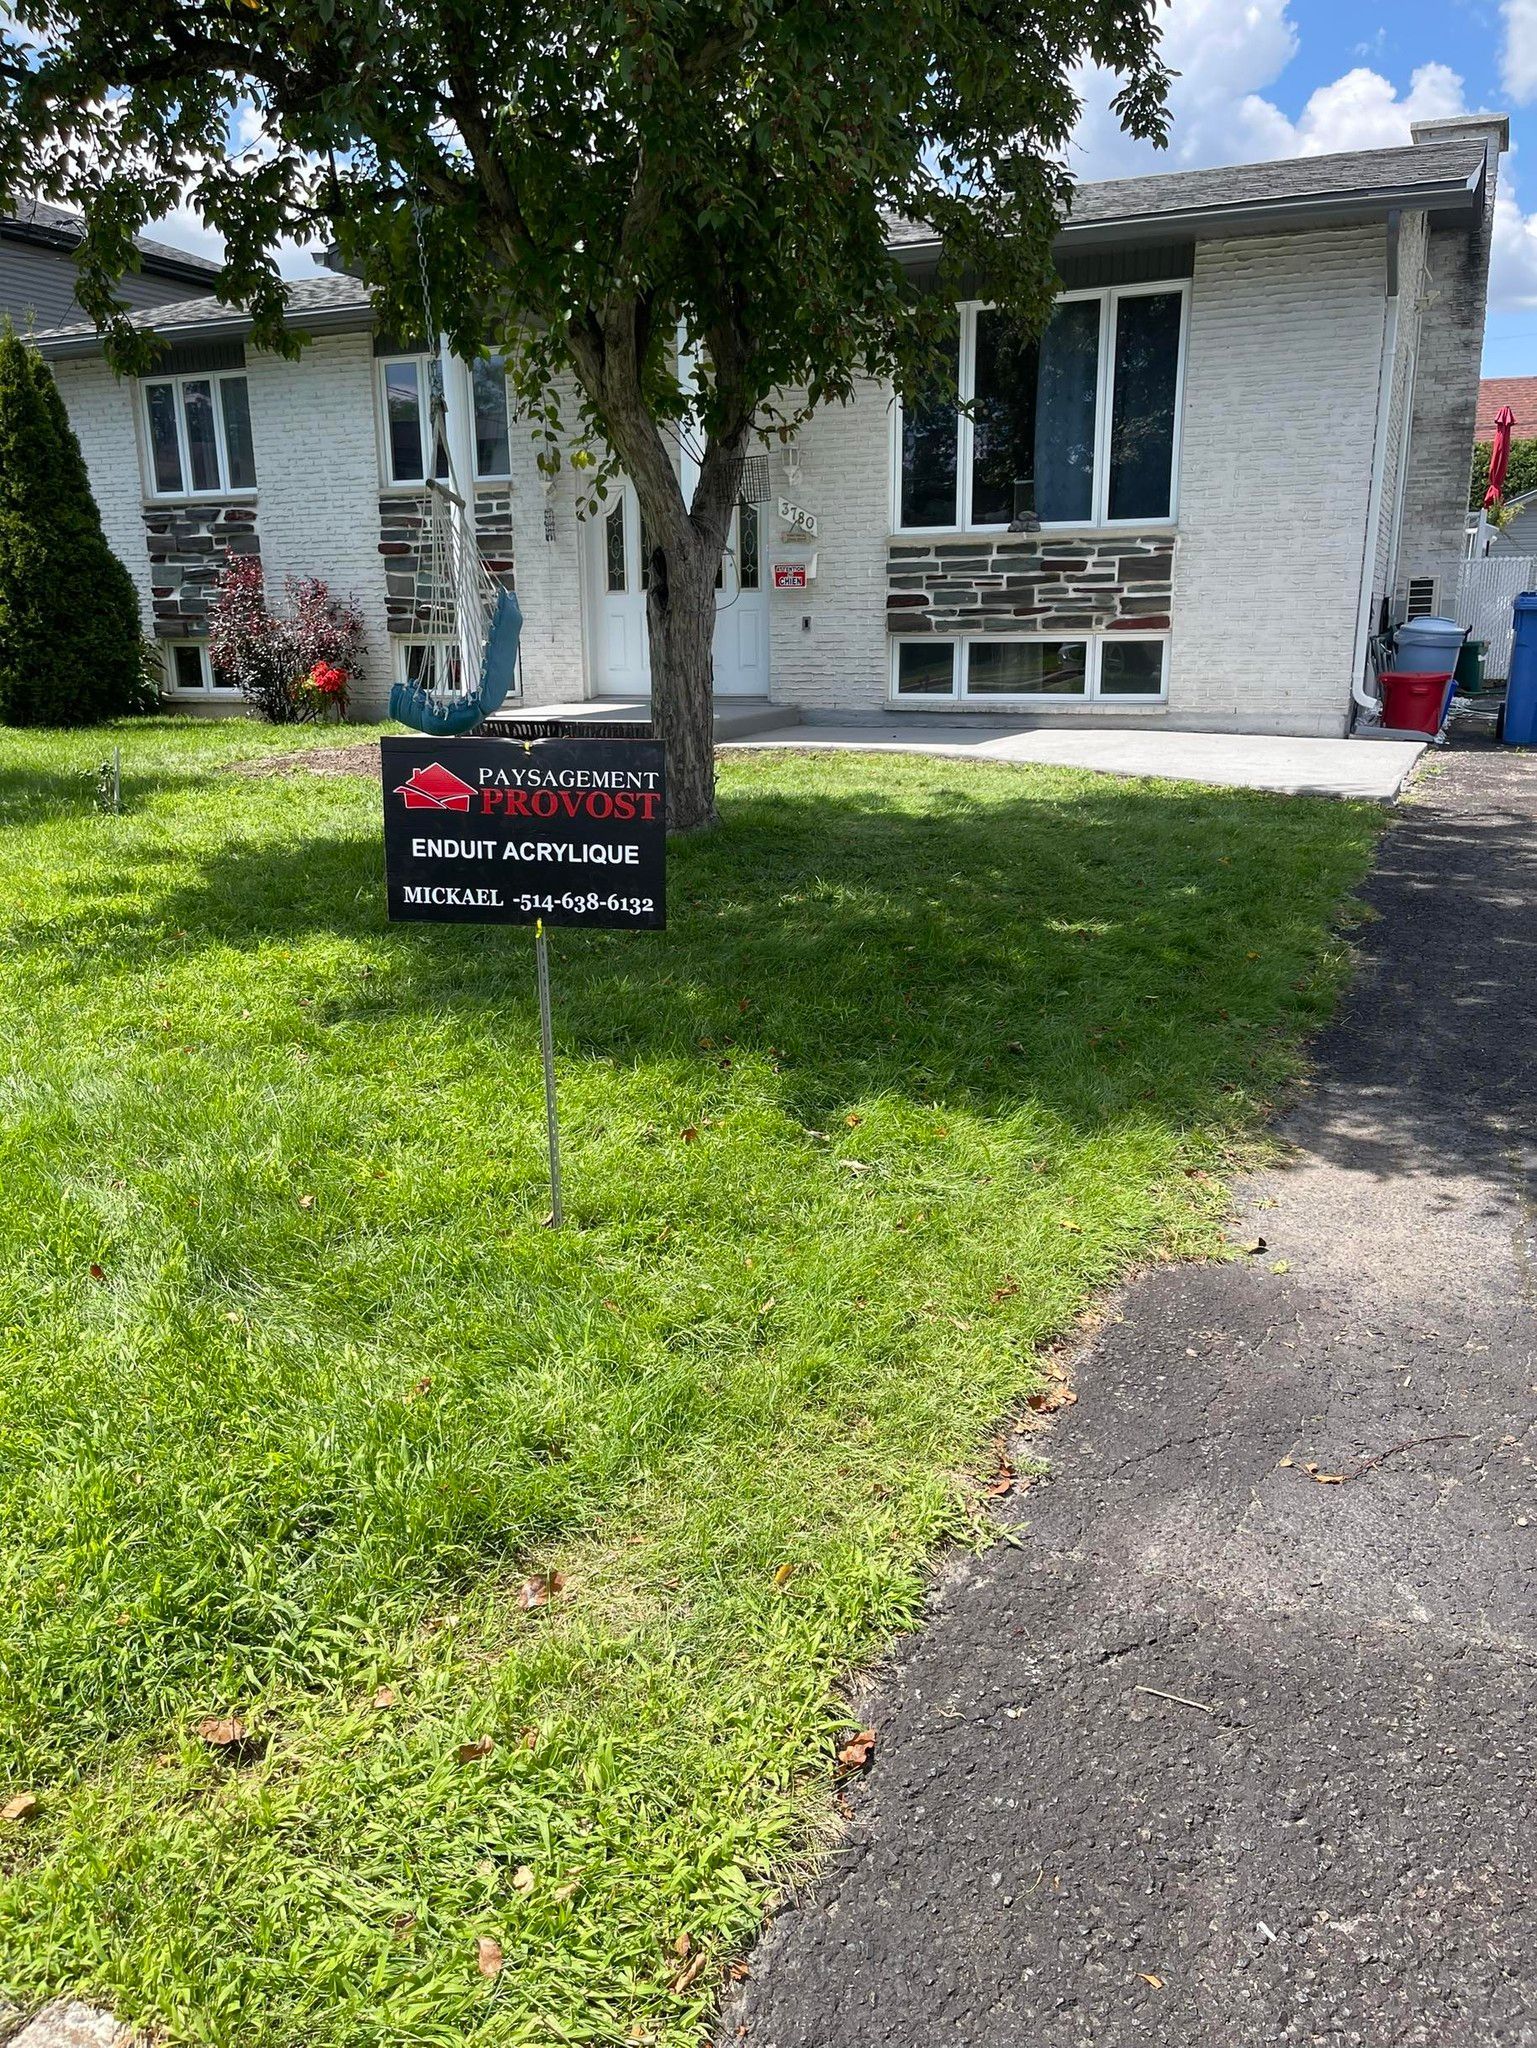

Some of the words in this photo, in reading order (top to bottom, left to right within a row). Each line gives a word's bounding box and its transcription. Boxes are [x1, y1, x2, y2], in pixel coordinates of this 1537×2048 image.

[782, 502, 815, 530] 3780
[779, 577, 802, 585] CHIEN
[479, 767, 660, 790] PAYSAGEMENT
[480, 788, 661, 820] PROVOST
[412, 838, 497, 860] ENDUIT
[502, 841, 640, 865] ACRYLIQUE
[403, 886, 504, 907] MICKAEL
[513, 891, 655, 915] -514-638-6132
